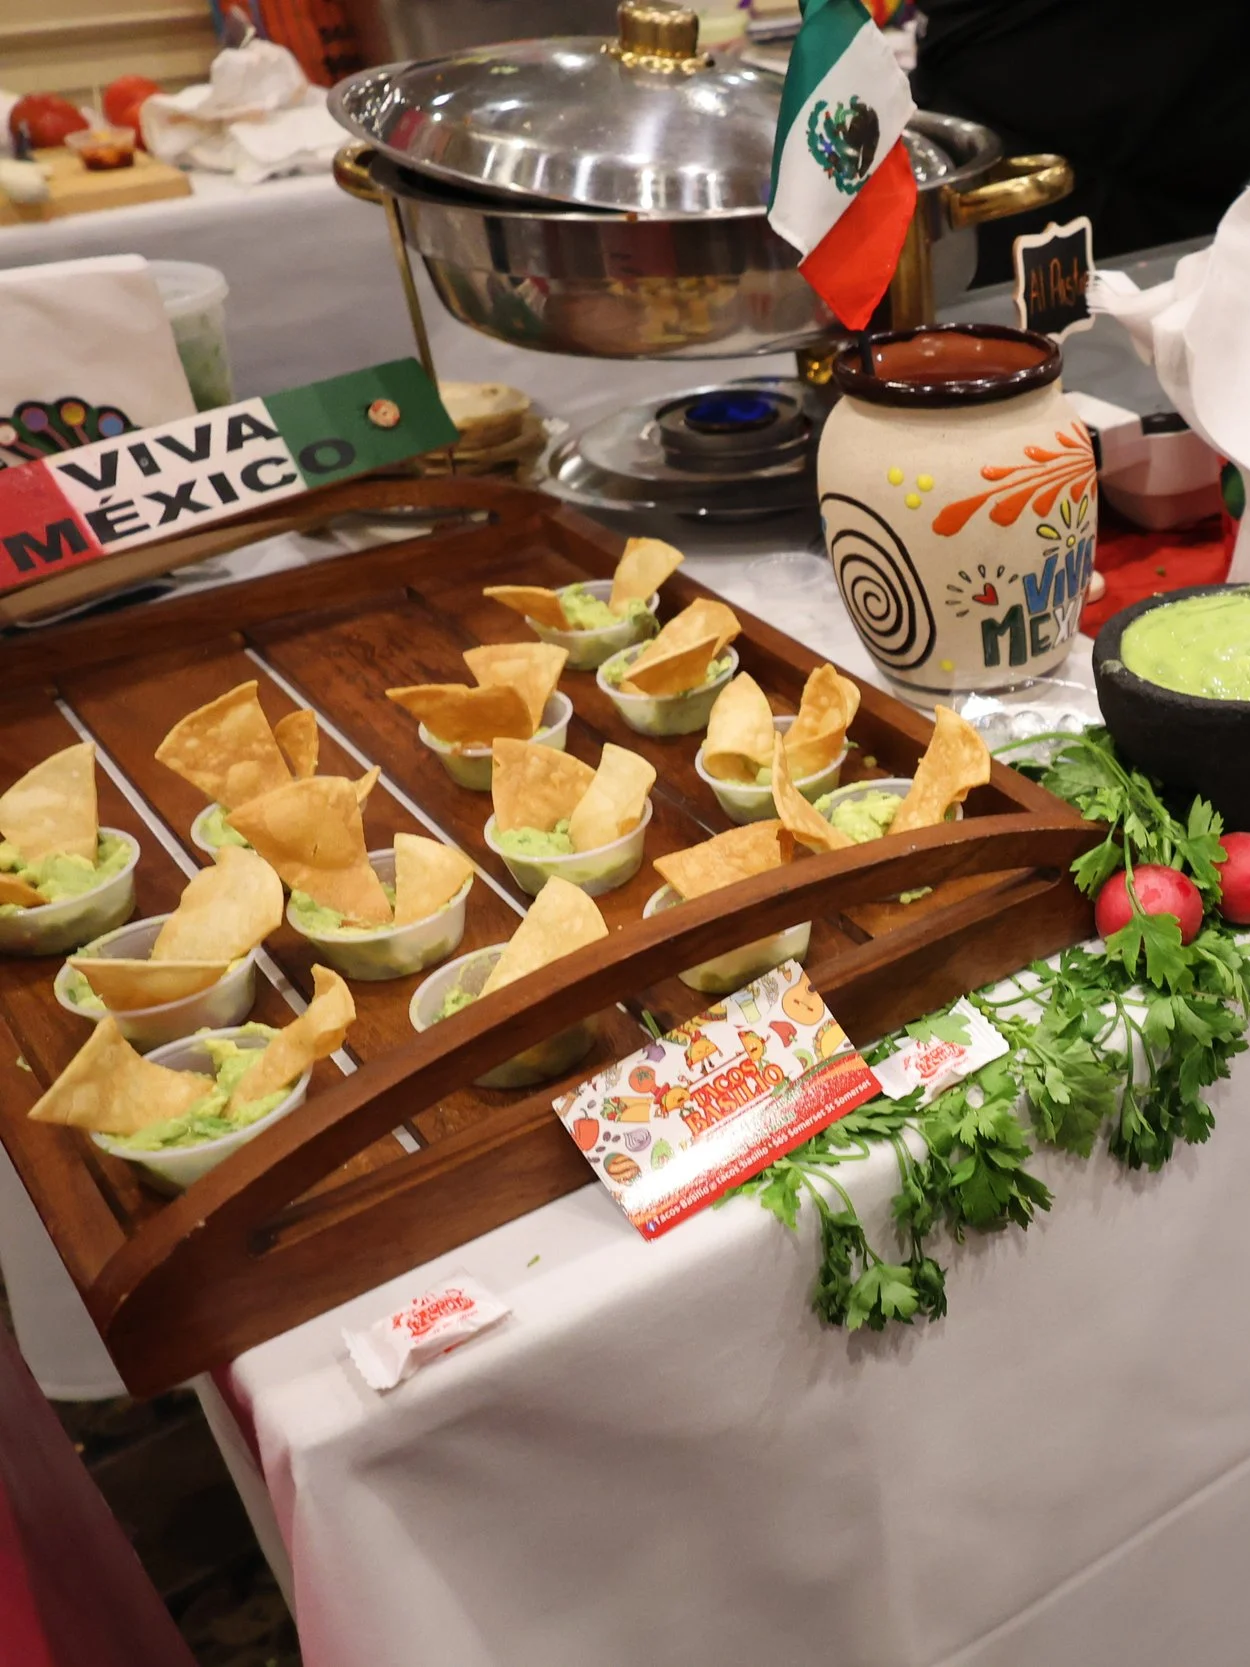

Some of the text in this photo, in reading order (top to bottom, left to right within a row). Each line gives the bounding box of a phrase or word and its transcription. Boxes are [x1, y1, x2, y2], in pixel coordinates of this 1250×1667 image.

[58, 412, 282, 492] VIVA
[3, 438, 356, 572] MÉXICO
[685, 1063, 785, 1137] BASILIO
[691, 1058, 758, 1108] TACOS
[834, 1080, 872, 1108] Somerset
